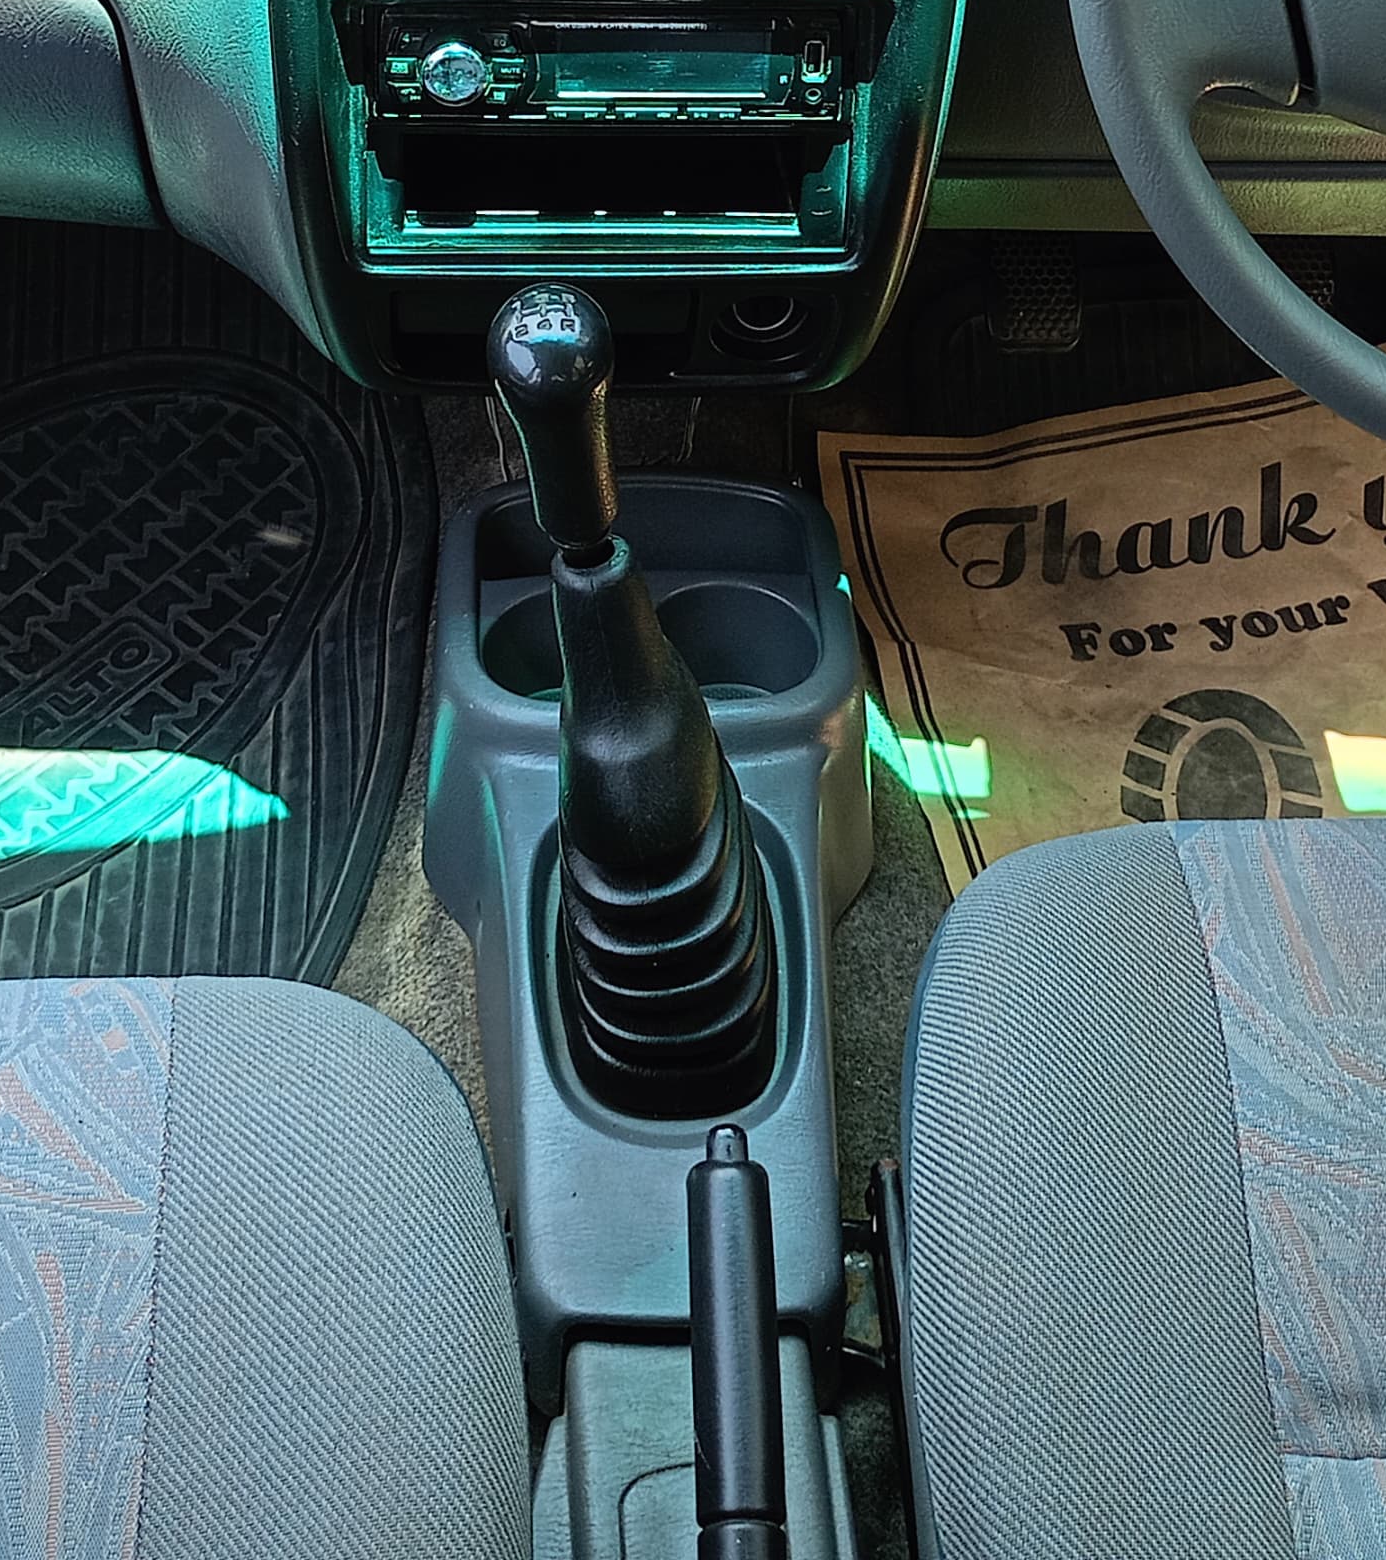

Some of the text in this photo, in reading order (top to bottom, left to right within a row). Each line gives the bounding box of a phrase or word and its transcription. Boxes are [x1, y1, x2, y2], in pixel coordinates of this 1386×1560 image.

[514, 324, 529, 338] 2
[560, 318, 576, 333] R
[940, 461, 1336, 589] Thank
[1060, 620, 1177, 662] For
[1200, 591, 1351, 651] your
[22, 636, 151, 746] ALTO
